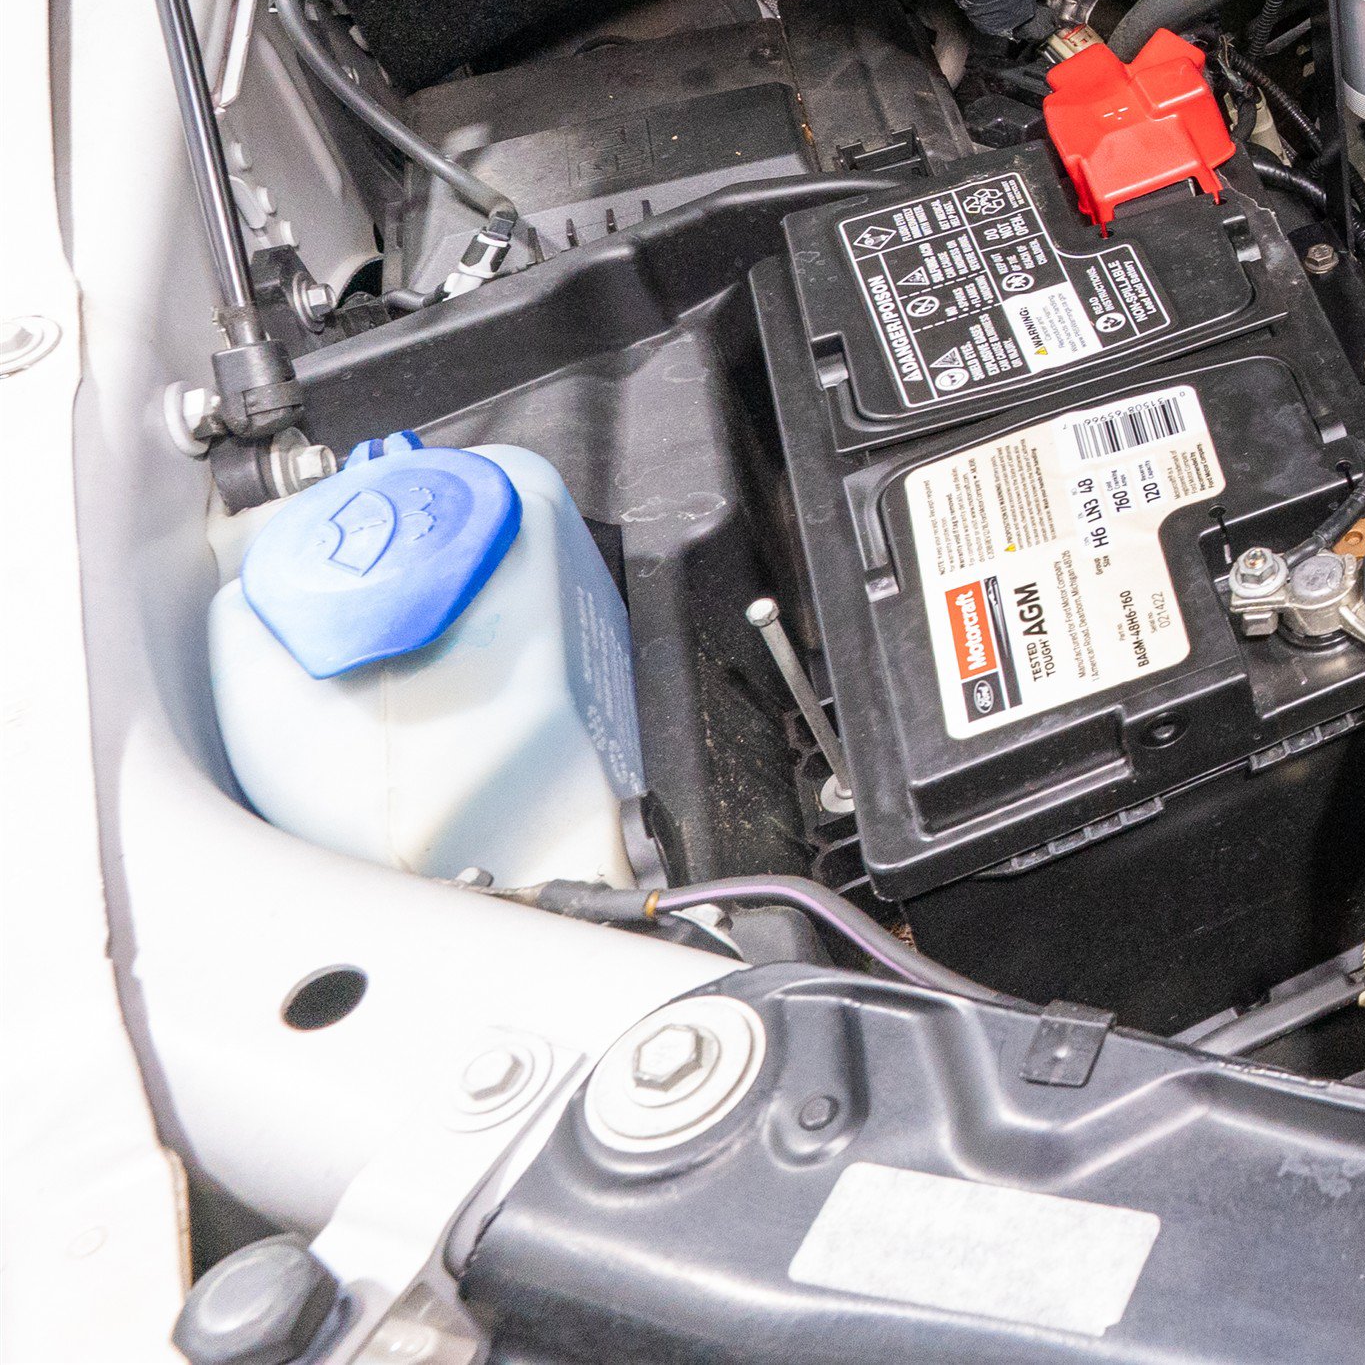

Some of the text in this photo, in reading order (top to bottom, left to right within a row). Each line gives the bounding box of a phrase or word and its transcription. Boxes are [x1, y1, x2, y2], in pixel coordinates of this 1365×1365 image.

[1000, 180, 1019, 207] BATTERY MUST
[1008, 179, 1022, 199] RECYCLED
[892, 212, 912, 241] FLUSH EYES
[902, 207, 922, 238] IMMEDIATELY
[912, 203, 933, 235] WITH WATER.
[930, 199, 951, 230] GET MEDICAL
[942, 200, 961, 227] HELP FAST.
[1009, 213, 1029, 236] OPEN.
[983, 227, 1000, 240] DO
[996, 221, 1014, 239] NOT
[918, 242, 944, 283] SULFURIC ACID
[937, 250, 956, 278] CAN CAUSE
[945, 239, 968, 274] BLINDNESS OR
[964, 251, 980, 271] SEVERE
[990, 252, 1008, 274] KEEP OUT
[1006, 254, 1022, 271] OF THE
[1016, 244, 1035, 269] REACH OF
[1028, 238, 1047, 265] CHILDREN.
[952, 286, 969, 308] SPARKS
[964, 282, 981, 304] FLAMES
[974, 274, 993, 300] SMOKING
[1086, 265, 1114, 311] INSTRUCTIONS.
[1107, 260, 1147, 322] NON-SPILLABLE
[1122, 259, 1157, 314] Lead Acid Battery
[944, 305, 958, 316] NO
[1088, 296, 1104, 315] READ
[868, 275, 918, 372] DANGER/POISON
[1018, 306, 1043, 348] WARNING:
[968, 323, 1000, 375] EXPLOSIVE GASES
[978, 313, 1011, 371] CAN CAUSE BLINDNESS
[1002, 337, 1023, 368] OR INJURY.
[959, 340, 985, 381] SHIELD EYES.
[1110, 469, 1120, 488] Cranking
[1137, 463, 1146, 481] Reserve
[1144, 459, 1153, 479] Capacity
[1191, 456, 1205, 491] Recommended
[1202, 463, 1211, 478] Motor
[1206, 476, 1214, 488] Ford
[1105, 480, 1113, 491] Cold
[1142, 481, 1161, 503] 120
[1077, 477, 1109, 548] H6 LN3 48
[1111, 489, 1131, 512] 760
[951, 519, 959, 530] tag
[956, 544, 965, 568] Warranty
[1061, 549, 1072, 568] 48126
[1093, 557, 1103, 575] Group
[1102, 554, 1110, 567] Size
[1067, 568, 1079, 597] Michigan
[1013, 582, 1047, 635] AGM
[1053, 560, 1086, 677] Manufactured for Ford Motor Company
[1150, 591, 1171, 628] 021422
[1080, 627, 1091, 646] Road,
[1117, 630, 1125, 641] Part
[1119, 590, 1149, 667] BAGM-48H6-760
[1148, 619, 1157, 633] Serial
[955, 590, 992, 710] Ford Motorcraft
[1026, 641, 1042, 681] TESTED
[1086, 646, 1099, 677] American
